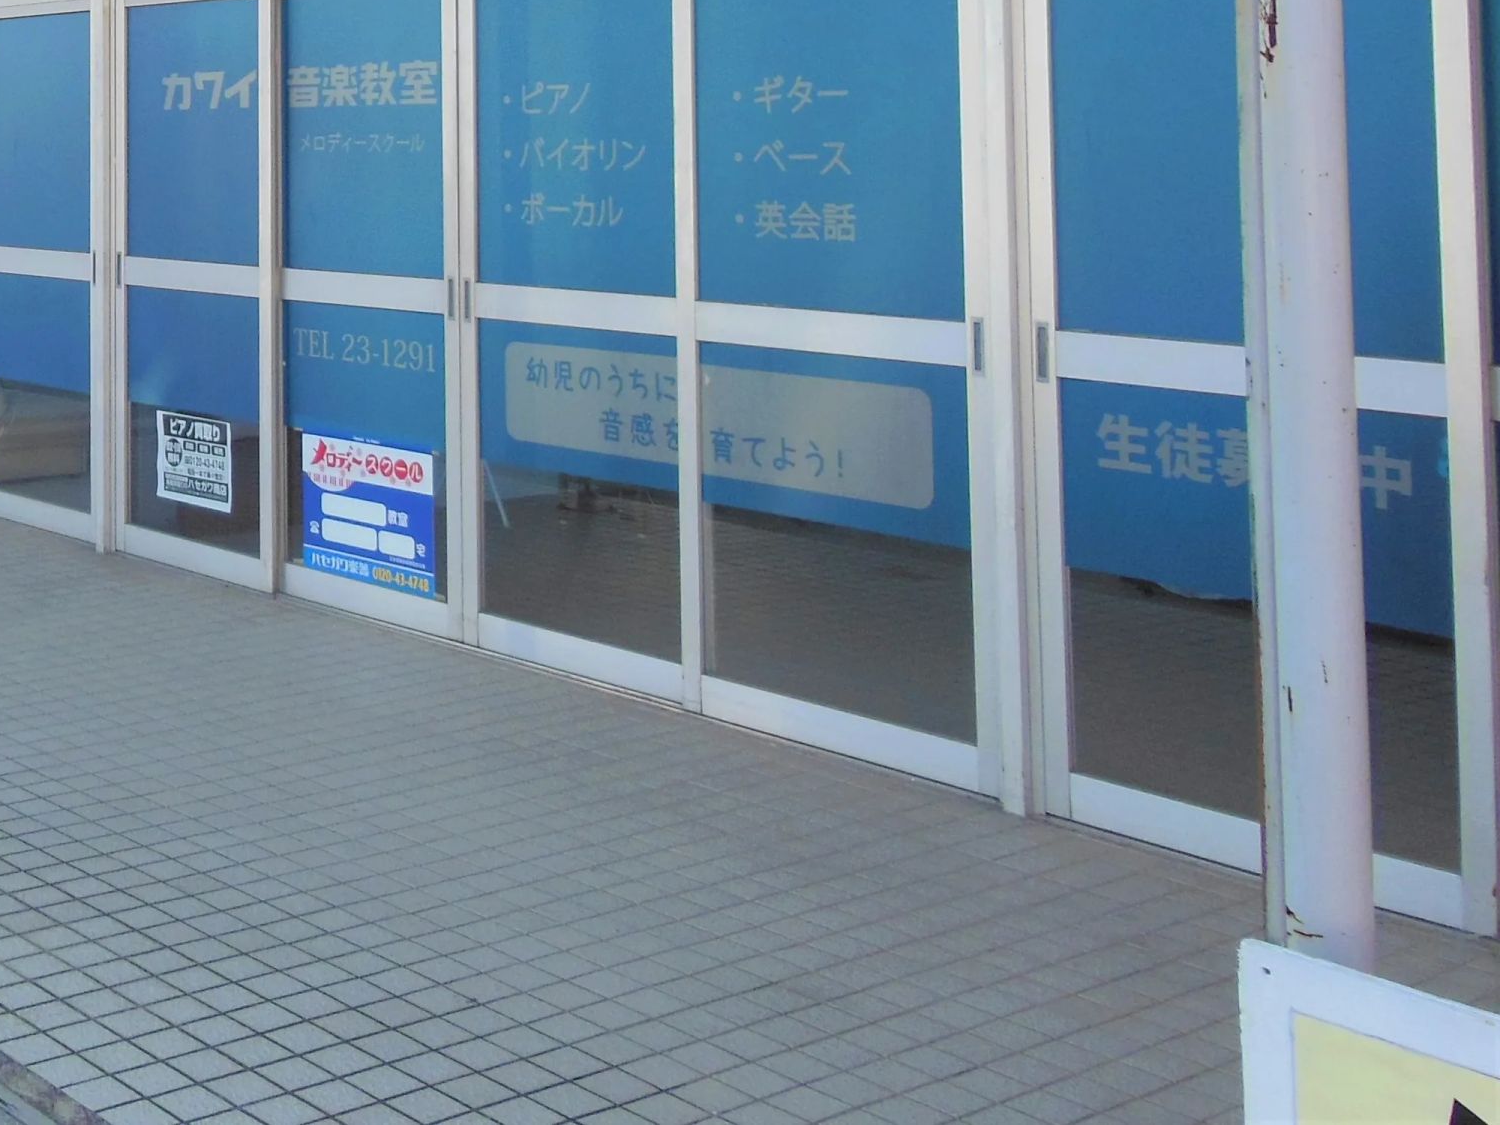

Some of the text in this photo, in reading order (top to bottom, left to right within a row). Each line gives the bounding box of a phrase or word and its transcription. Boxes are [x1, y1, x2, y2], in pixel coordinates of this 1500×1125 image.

[286, 60, 439, 109] 音楽教室
[520, 82, 591, 115] ピアノ
[753, 76, 850, 114] ギター
[300, 131, 424, 154] メロディースクール
[519, 138, 647, 172] バイオリン
[753, 139, 853, 176] ベース
[520, 193, 625, 227] ボーカル
[753, 201, 857, 243] 英会話
[293, 328, 437, 374] TEL 23-1291
[525, 356, 678, 404] 幼児のうちに
